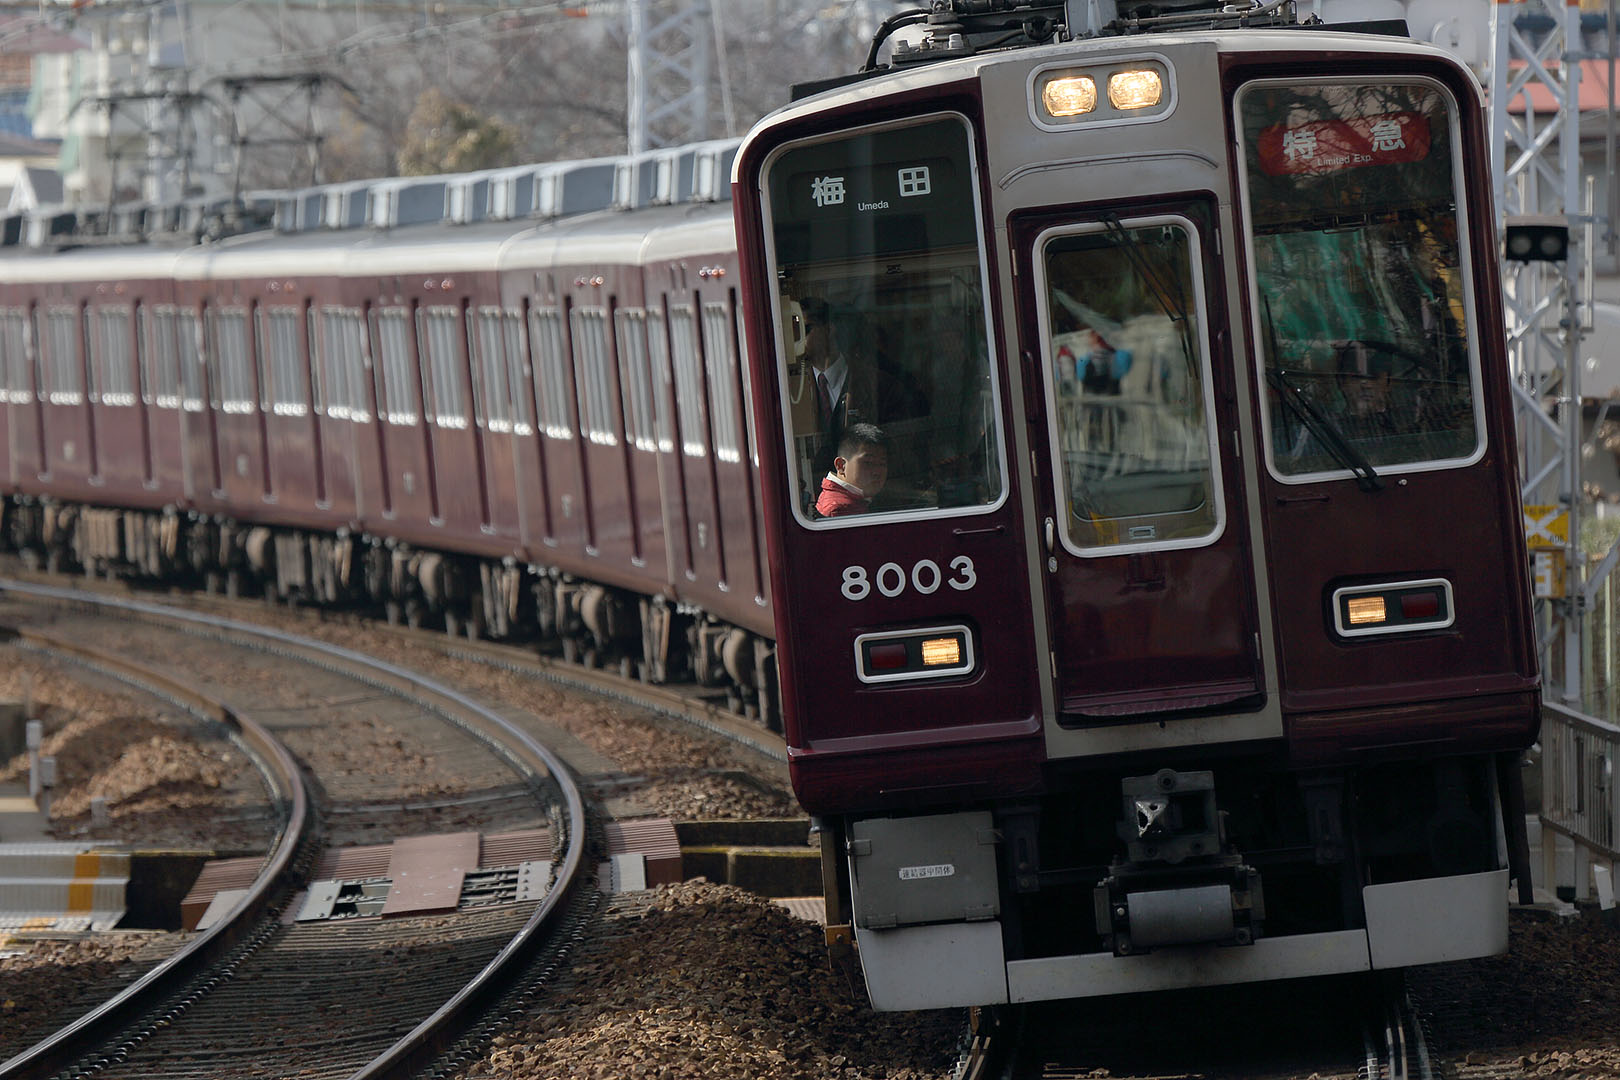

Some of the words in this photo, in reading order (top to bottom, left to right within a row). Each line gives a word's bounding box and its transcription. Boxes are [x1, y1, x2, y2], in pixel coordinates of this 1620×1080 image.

[1282, 120, 1406, 161] 特急
[1317, 156, 1350, 167] Limited
[1354, 153, 1374, 163] Exp.
[811, 166, 931, 207] 梅田
[857, 200, 889, 211] Umeda
[840, 555, 977, 601] 8003
